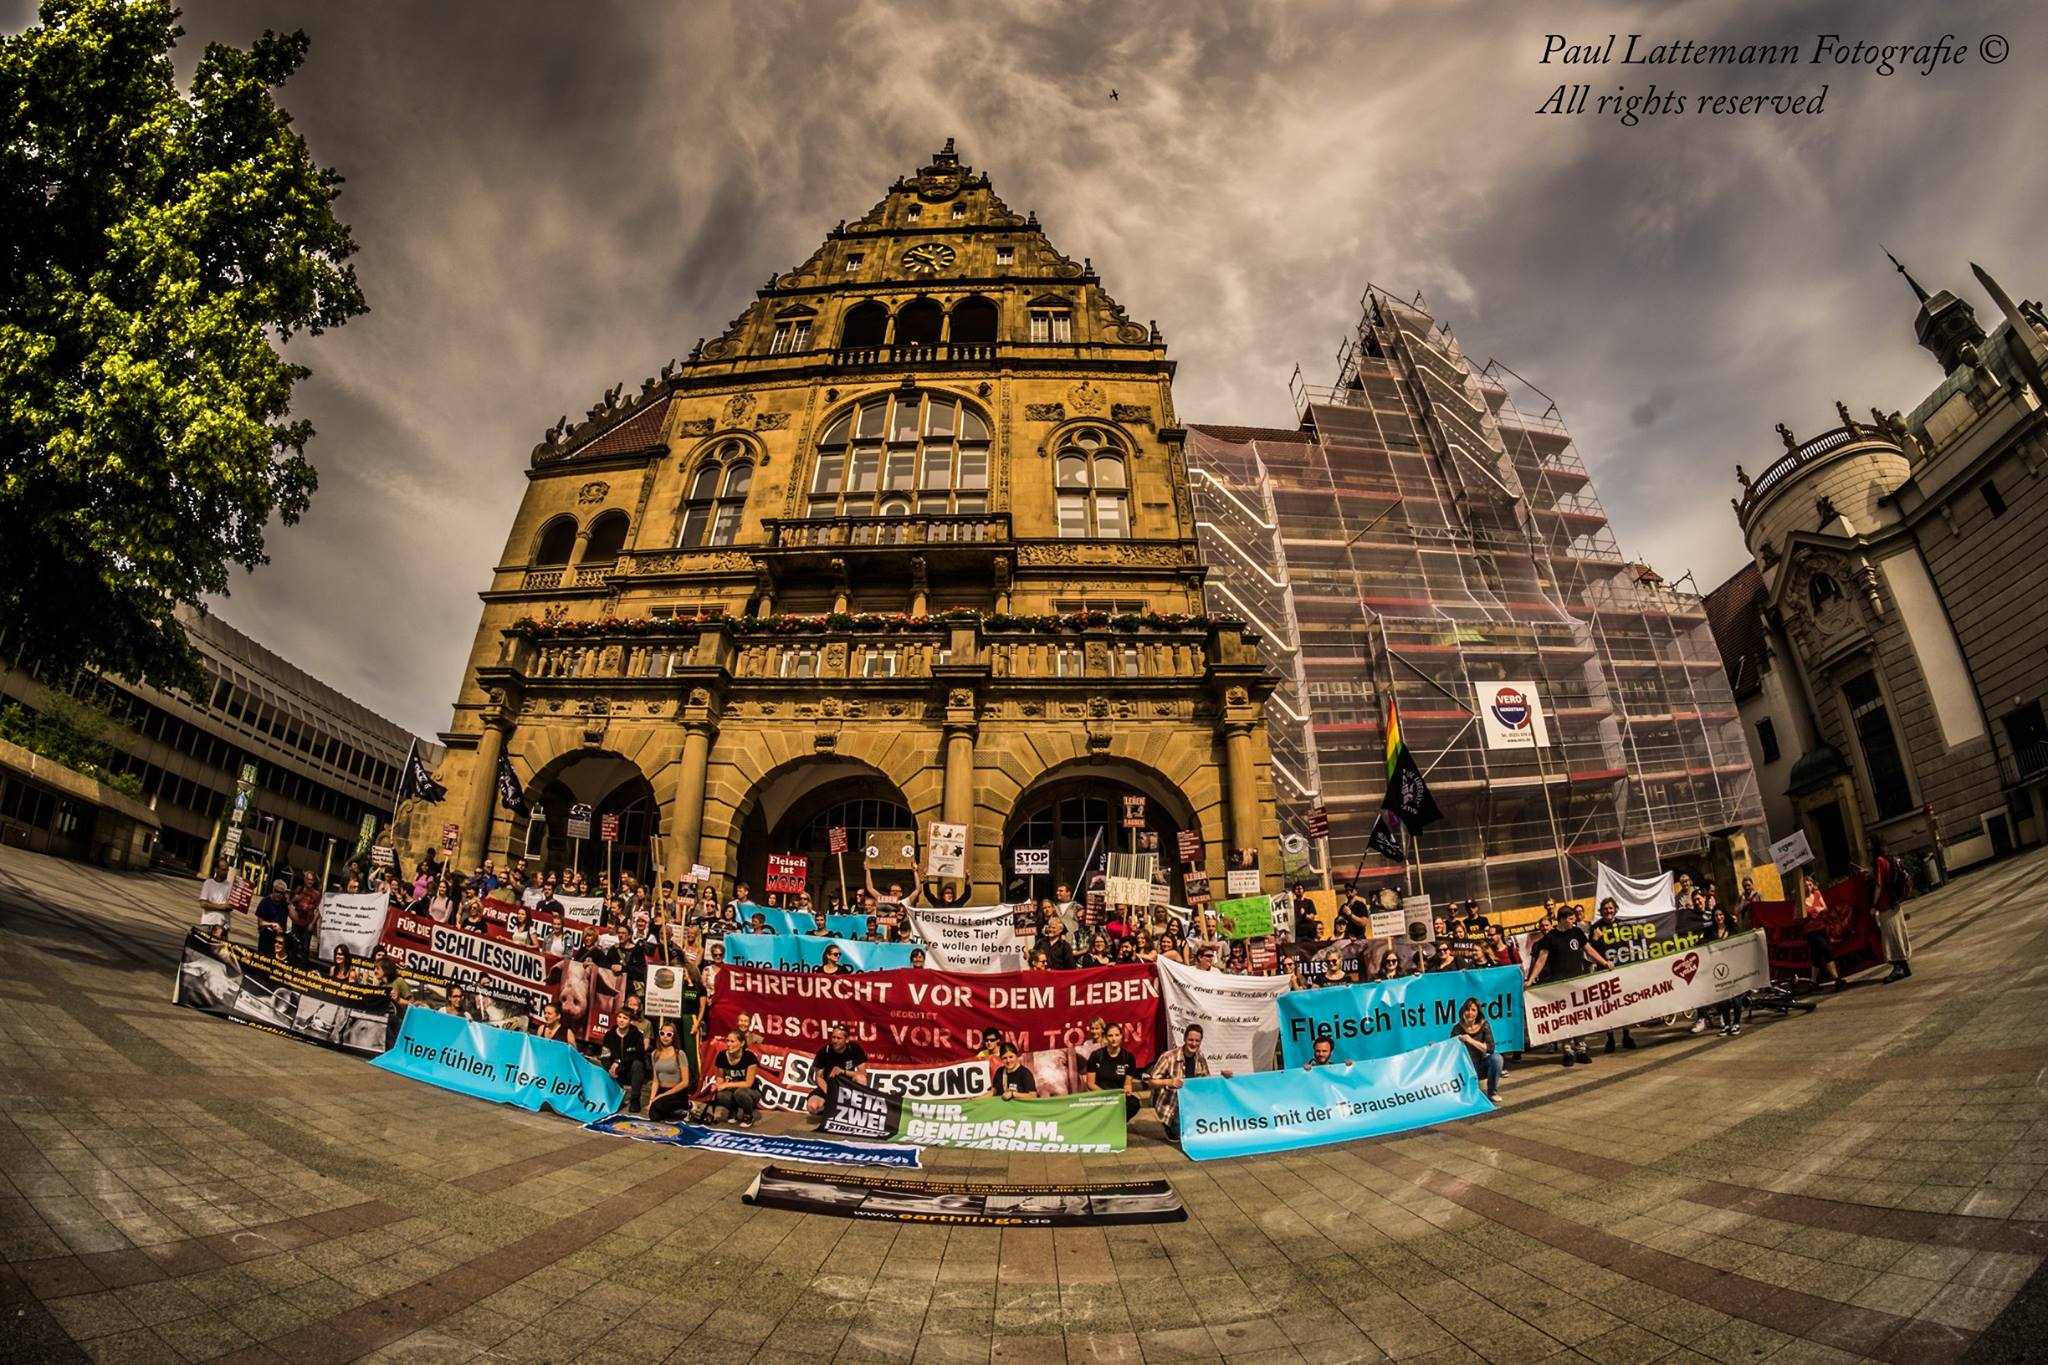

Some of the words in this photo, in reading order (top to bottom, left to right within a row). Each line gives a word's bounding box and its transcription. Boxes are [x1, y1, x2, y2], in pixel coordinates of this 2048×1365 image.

[1497, 695, 1522, 704] VERO
[769, 856, 807, 867] Fleisch
[1016, 852, 1048, 861] STOP
[768, 874, 805, 890] MORD
[483, 907, 497, 919] FÜR
[497, 911, 508, 922] DIE
[914, 910, 954, 926] Fleisch
[958, 915, 972, 926] ist
[975, 917, 993, 927] ein
[397, 917, 417, 934] FÜR
[417, 923, 431, 938] DIE
[942, 929, 969, 939] totes
[974, 929, 999, 940] Tier!
[1602, 922, 1657, 945] tiere
[433, 929, 543, 982] SCHLIESSUNG
[942, 943, 978, 952] wollen
[981, 943, 1012, 953] leben
[947, 954, 966, 964] wie
[969, 955, 991, 965] wir!
[271, 958, 293, 971] Dienst
[293, 966, 306, 975] des
[307, 969, 341, 987] Menschen
[293, 975, 323, 992] erduldet,
[730, 970, 893, 1004] EHRFURCHT
[908, 982, 973, 1008] VOR
[989, 987, 1055, 1009] DEM
[1069, 976, 1160, 1007] LEBEN
[1193, 986, 1213, 994] etwas
[1532, 999, 1567, 1019] BRING
[1570, 976, 1622, 1008] LIEBE
[890, 1010, 939, 1021] BEDEUTET
[1537, 1022, 1550, 1035] IN
[1551, 1007, 1593, 1031] DEINEN
[1595, 980, 1675, 1019] KÜHLSCHRANK
[1199, 1012, 1212, 1021] den
[1216, 1015, 1241, 1023] Anblick
[1291, 1007, 1391, 1042] Fleisch
[1400, 1003, 1426, 1028] ist
[890, 1024, 952, 1049] VOR
[966, 1028, 1030, 1052] DM
[760, 1054, 784, 1070] DIE
[404, 1036, 437, 1061] Tiere
[439, 1047, 497, 1082] fühlen,
[505, 1063, 547, 1090] Tiere
[551, 1077, 607, 1113] leiden!
[837, 1086, 888, 1114] PETA
[1196, 1113, 1268, 1135] Schluss
[1273, 1108, 1301, 1128] mit
[1306, 1105, 1332, 1122] der
[1335, 1072, 1466, 1118] Tierausbeutung!
[835, 1106, 887, 1131] ZWEI
[911, 1102, 968, 1122] WIR.
[907, 1119, 1065, 1142] GEMEINSAM.
[853, 1210, 1052, 1226] www.earthlings.de
